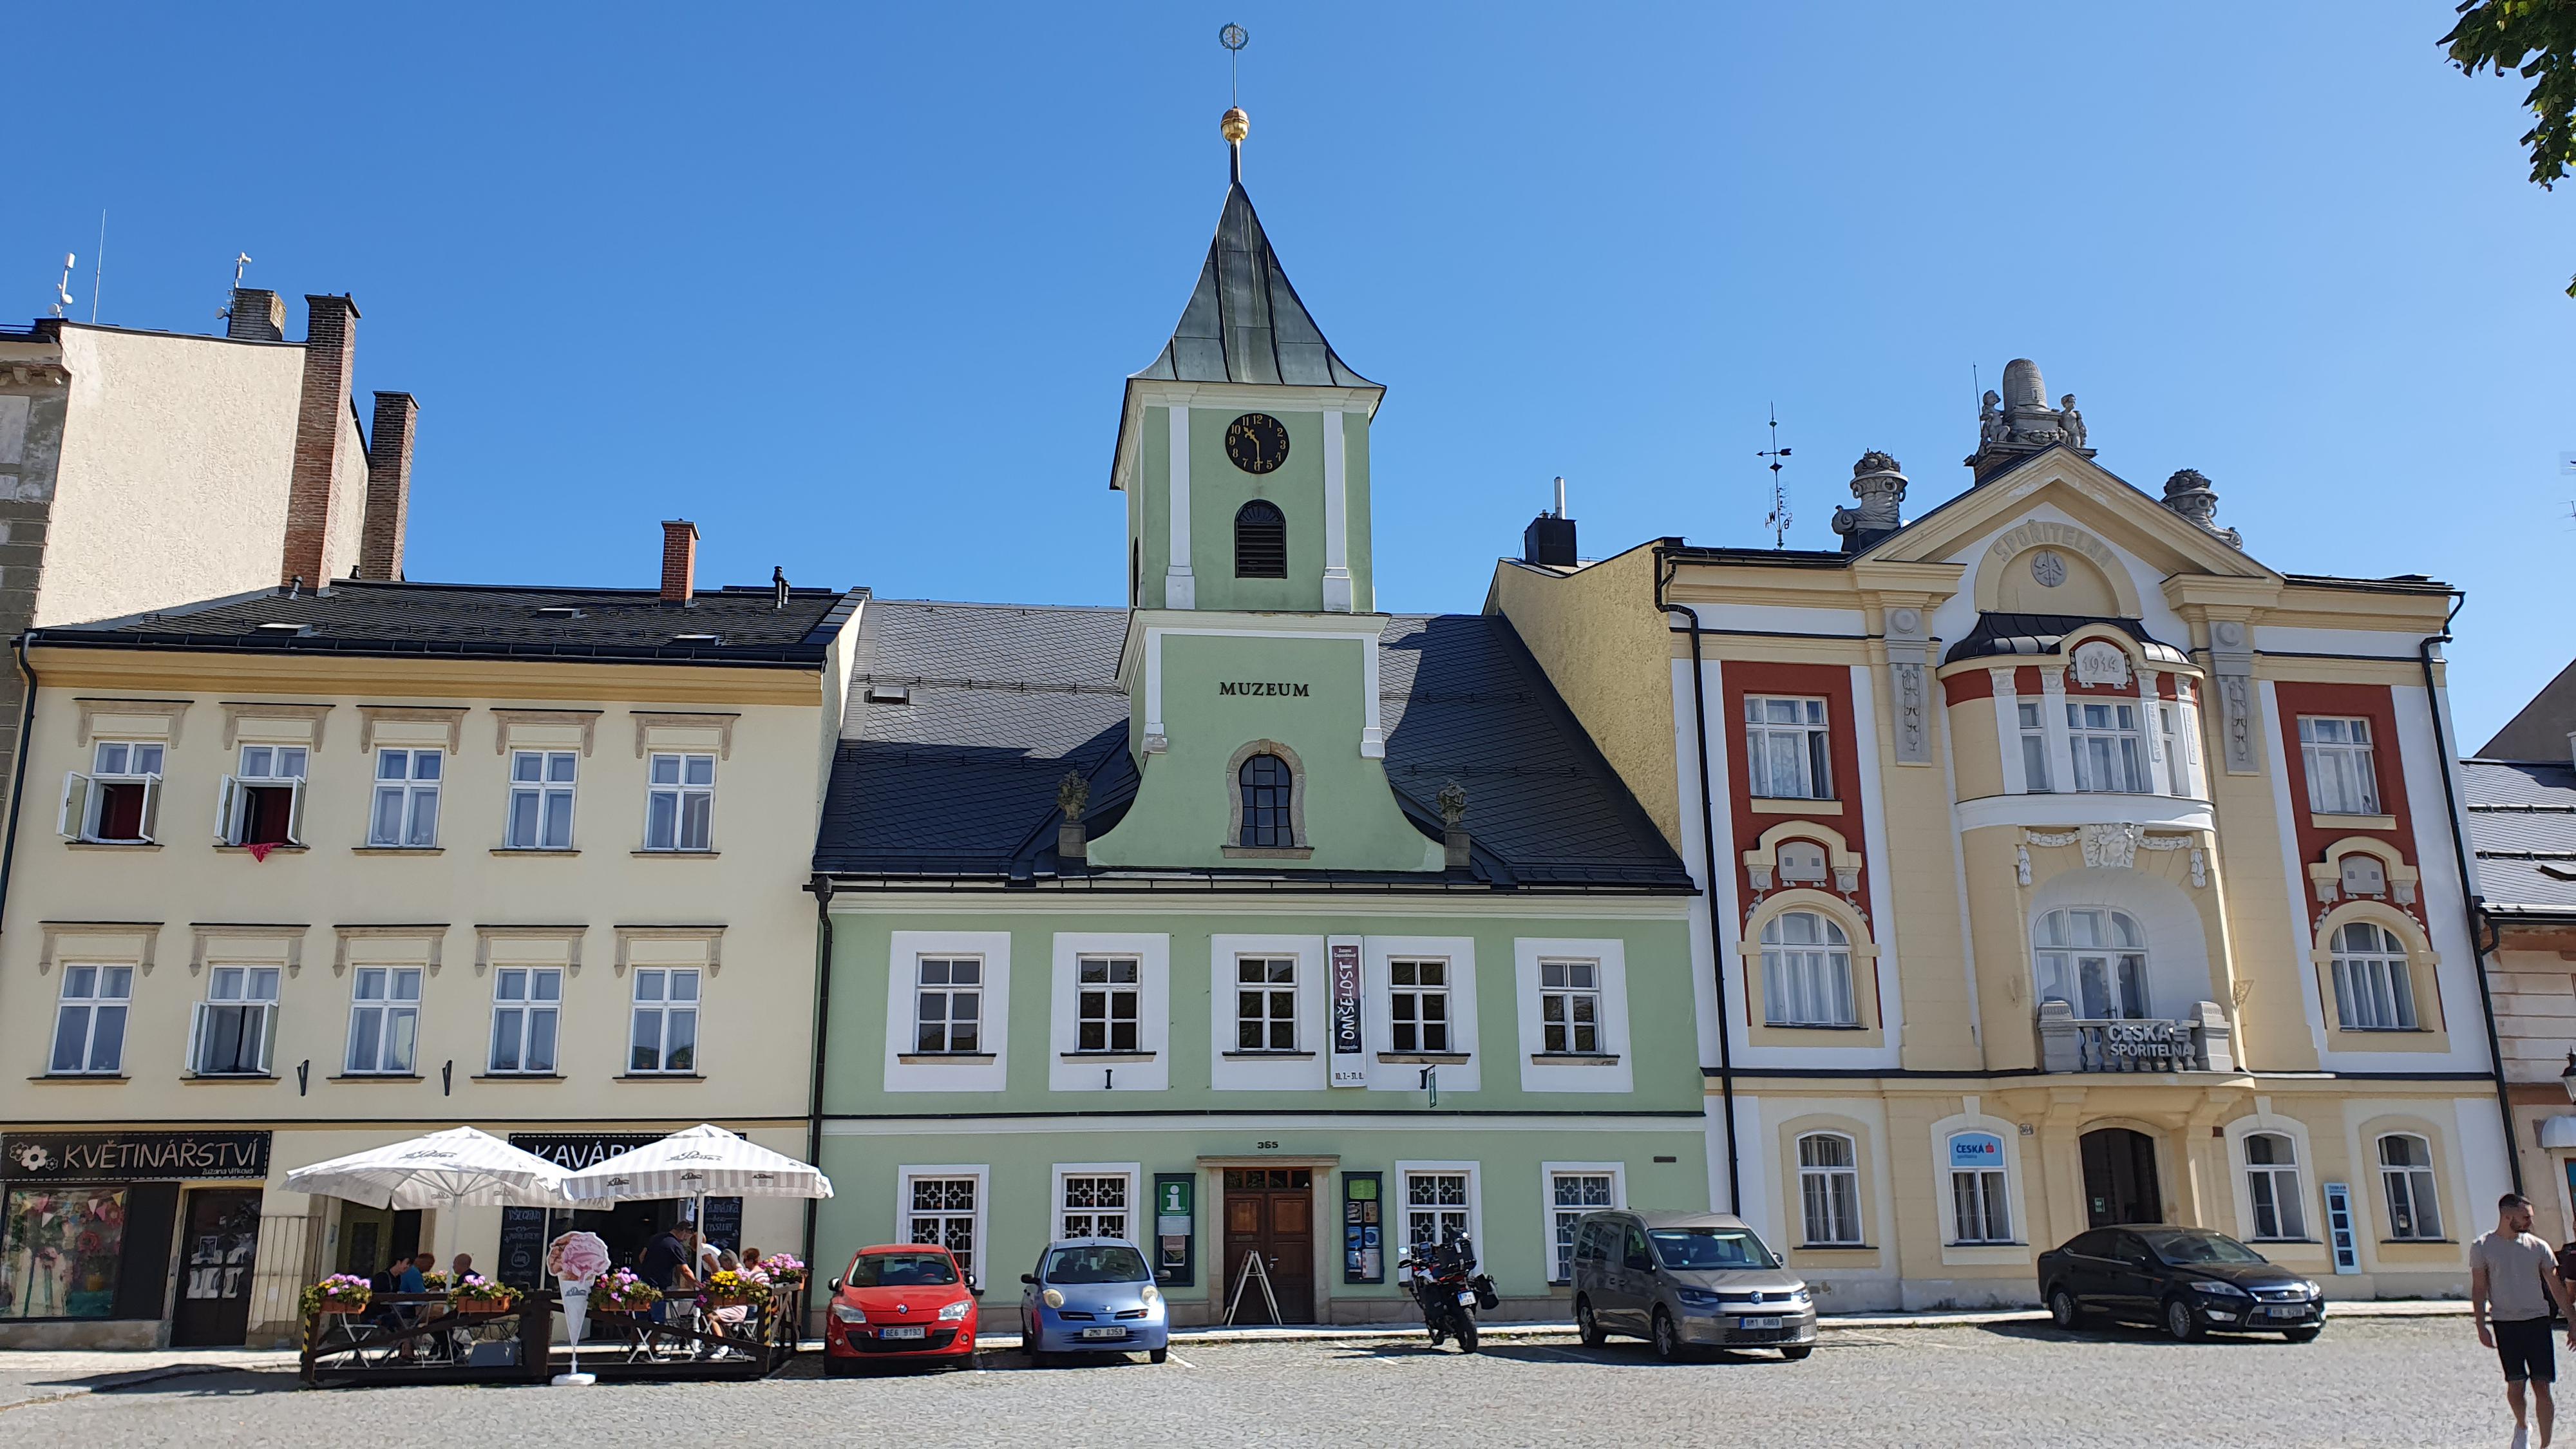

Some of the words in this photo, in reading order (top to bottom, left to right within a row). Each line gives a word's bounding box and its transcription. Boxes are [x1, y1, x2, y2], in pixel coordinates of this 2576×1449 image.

[1242, 416, 1249, 426] 11
[1253, 415, 1262, 424] 12
[1268, 419, 1272, 428] 1
[1231, 424, 1241, 435] 10
[1277, 428, 1283, 437] 2
[1229, 436, 1236, 446] 9
[1280, 440, 1286, 450] 3
[1233, 448, 1238, 458] 8
[1276, 452, 1281, 461] 4
[1242, 458, 1248, 468] 7
[1266, 460, 1273, 469] 5
[1219, 682, 1309, 697] MUZEUM
[1337, 961, 1355, 1040] OMŠELOST
[1257, 1141, 1278, 1149] 365
[1956, 1142, 1984, 1153] ČESKÁ
[63, 1139, 258, 1169] KVĚTINÁŘSTVÍ
[535, 1140, 636, 1168] KAVÁR
